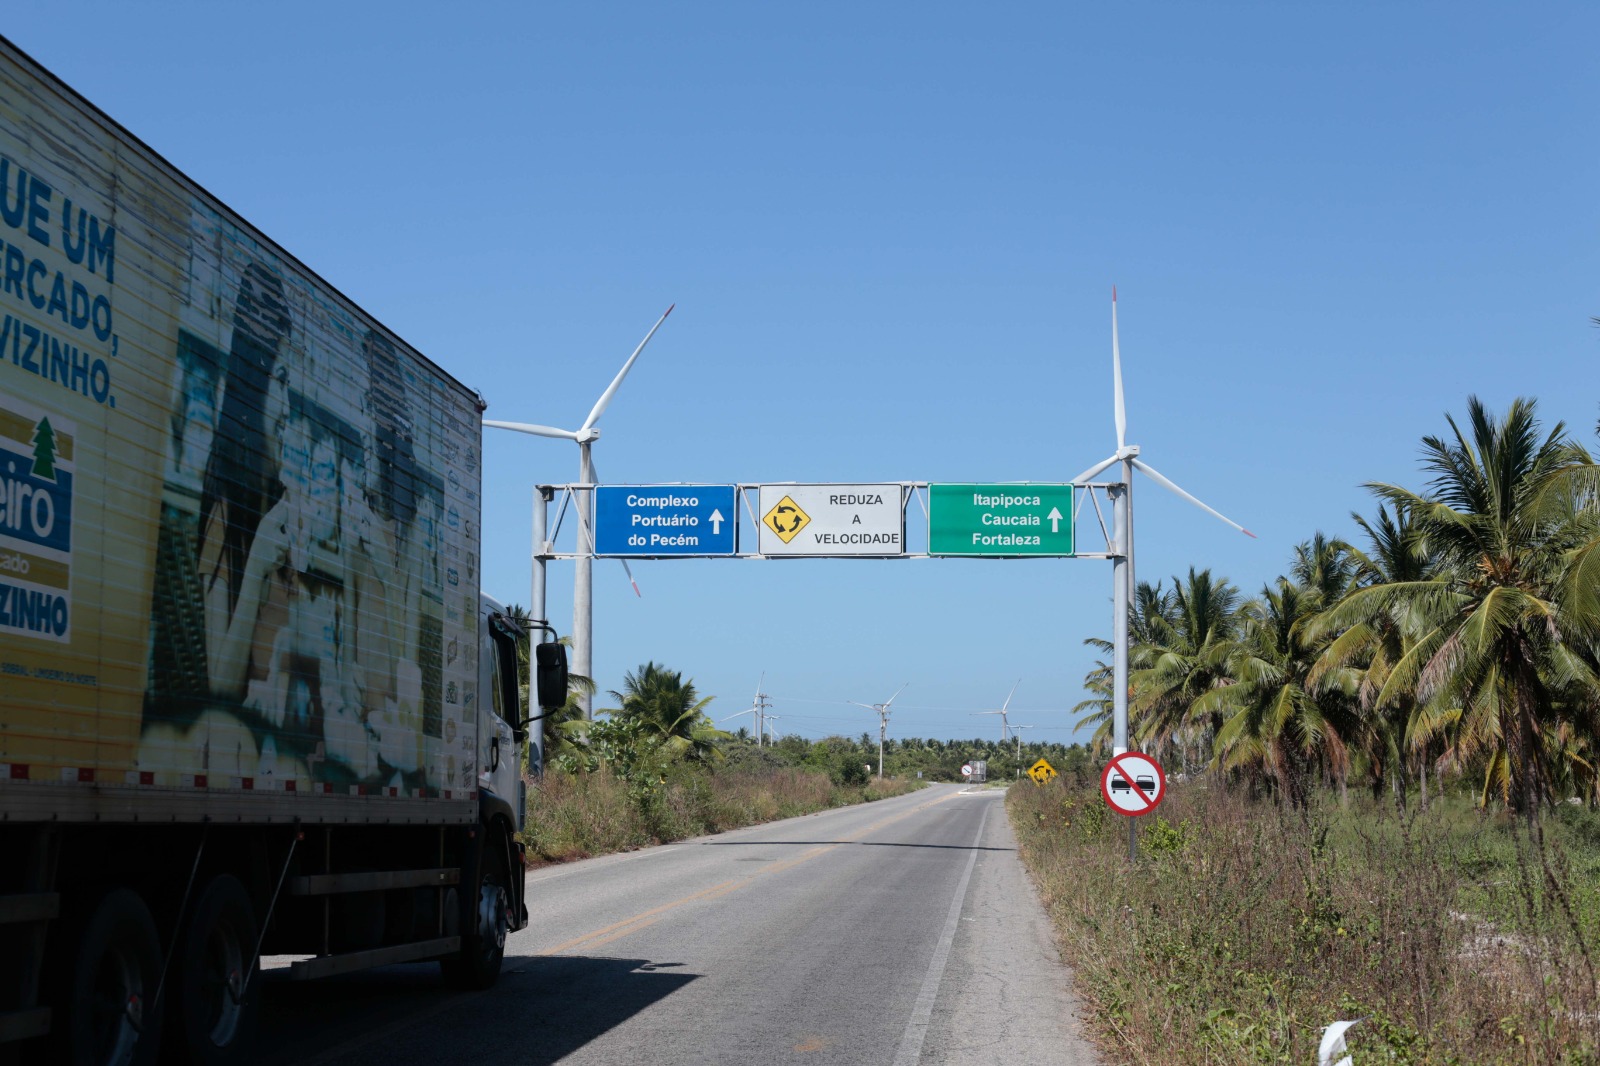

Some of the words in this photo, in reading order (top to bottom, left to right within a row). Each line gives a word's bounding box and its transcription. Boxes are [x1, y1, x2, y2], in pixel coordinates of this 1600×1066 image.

[62, 198, 116, 284] UM
[626, 494, 699, 509] Complexo
[829, 494, 883, 505] REDUZA
[973, 493, 1041, 508] Itapipoca
[631, 514, 699, 527] Portuário
[852, 514, 861, 524] A
[981, 512, 1041, 526] Caucaia
[628, 533, 646, 546] do
[650, 533, 699, 546] Pecém
[814, 533, 899, 544] VELOCIDADE
[972, 532, 1041, 546] Fortaleza
